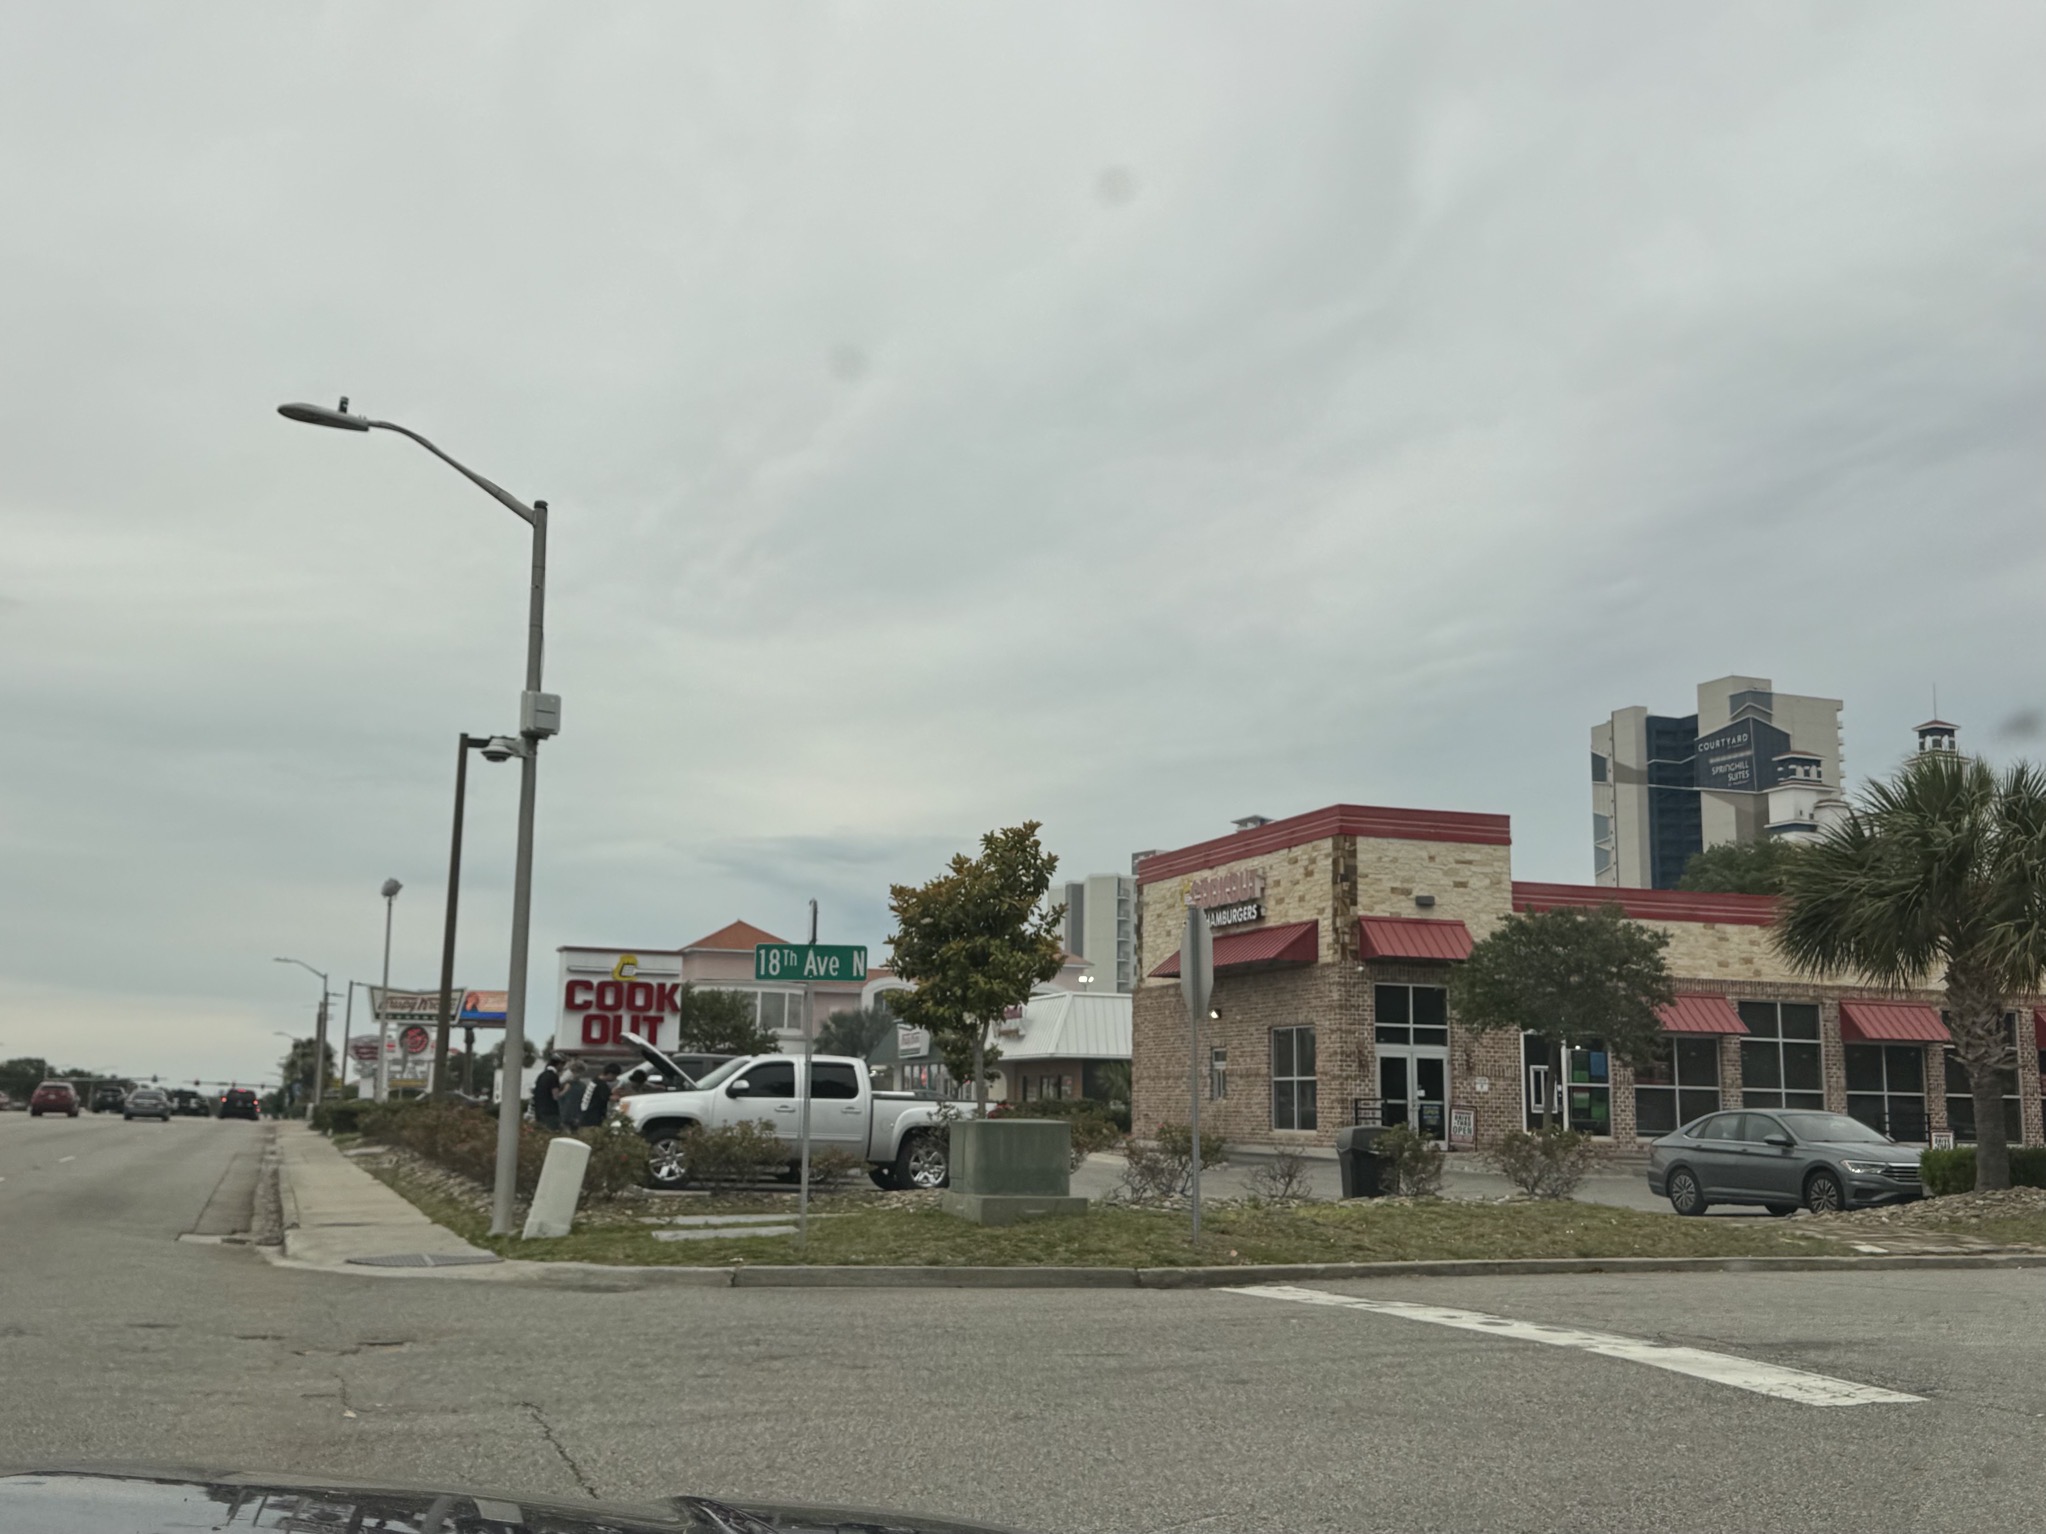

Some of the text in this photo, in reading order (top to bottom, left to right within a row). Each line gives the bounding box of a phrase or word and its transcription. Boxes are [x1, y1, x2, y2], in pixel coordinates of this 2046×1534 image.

[1698, 733, 1748, 752] COURTYARD
[1712, 761, 1749, 775] SPRINGHILL
[1728, 770, 1750, 782] SUITES
[803, 948, 840, 976] Ave
[852, 950, 865, 977] N
[565, 979, 681, 1012] COOK
[581, 1014, 664, 1045] OUT
[1452, 1126, 1472, 1135] OPEN
